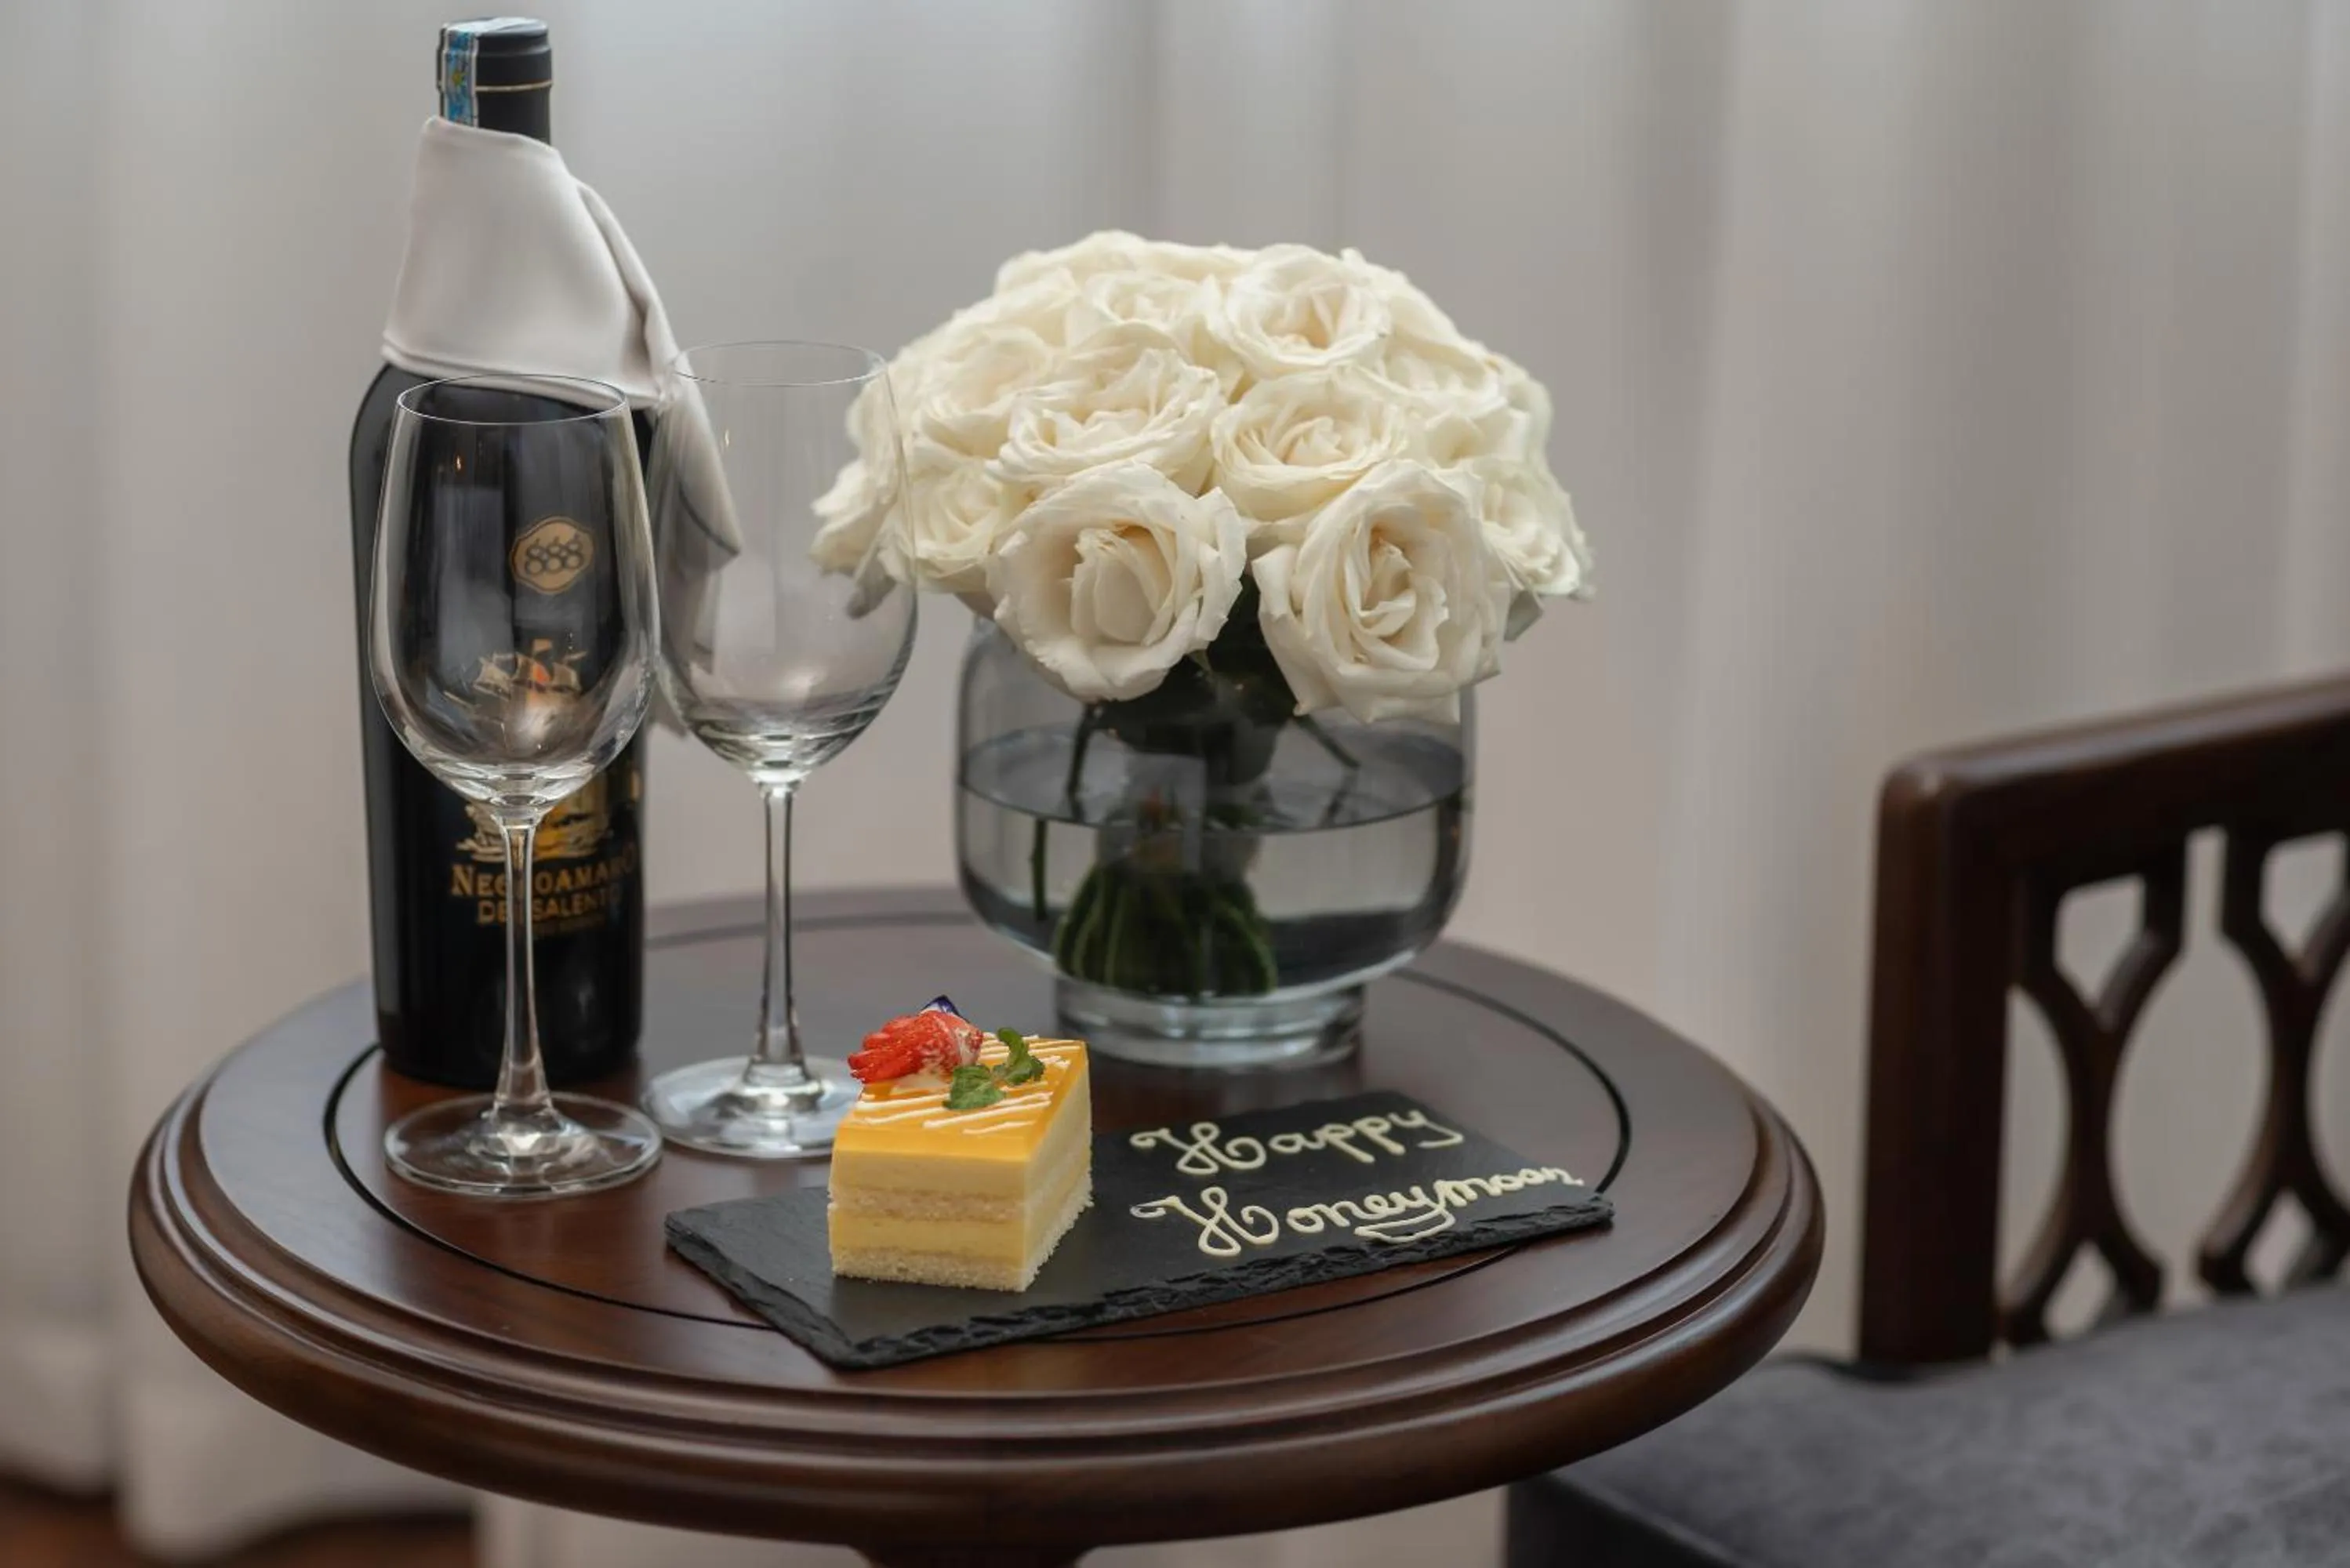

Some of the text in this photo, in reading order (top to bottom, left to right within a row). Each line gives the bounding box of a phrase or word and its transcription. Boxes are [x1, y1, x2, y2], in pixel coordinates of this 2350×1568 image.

[451, 845, 636, 897] NEGOAMARO
[1129, 1110, 1464, 1174] Happy
[1129, 1167, 1585, 1256] Honeymoon
